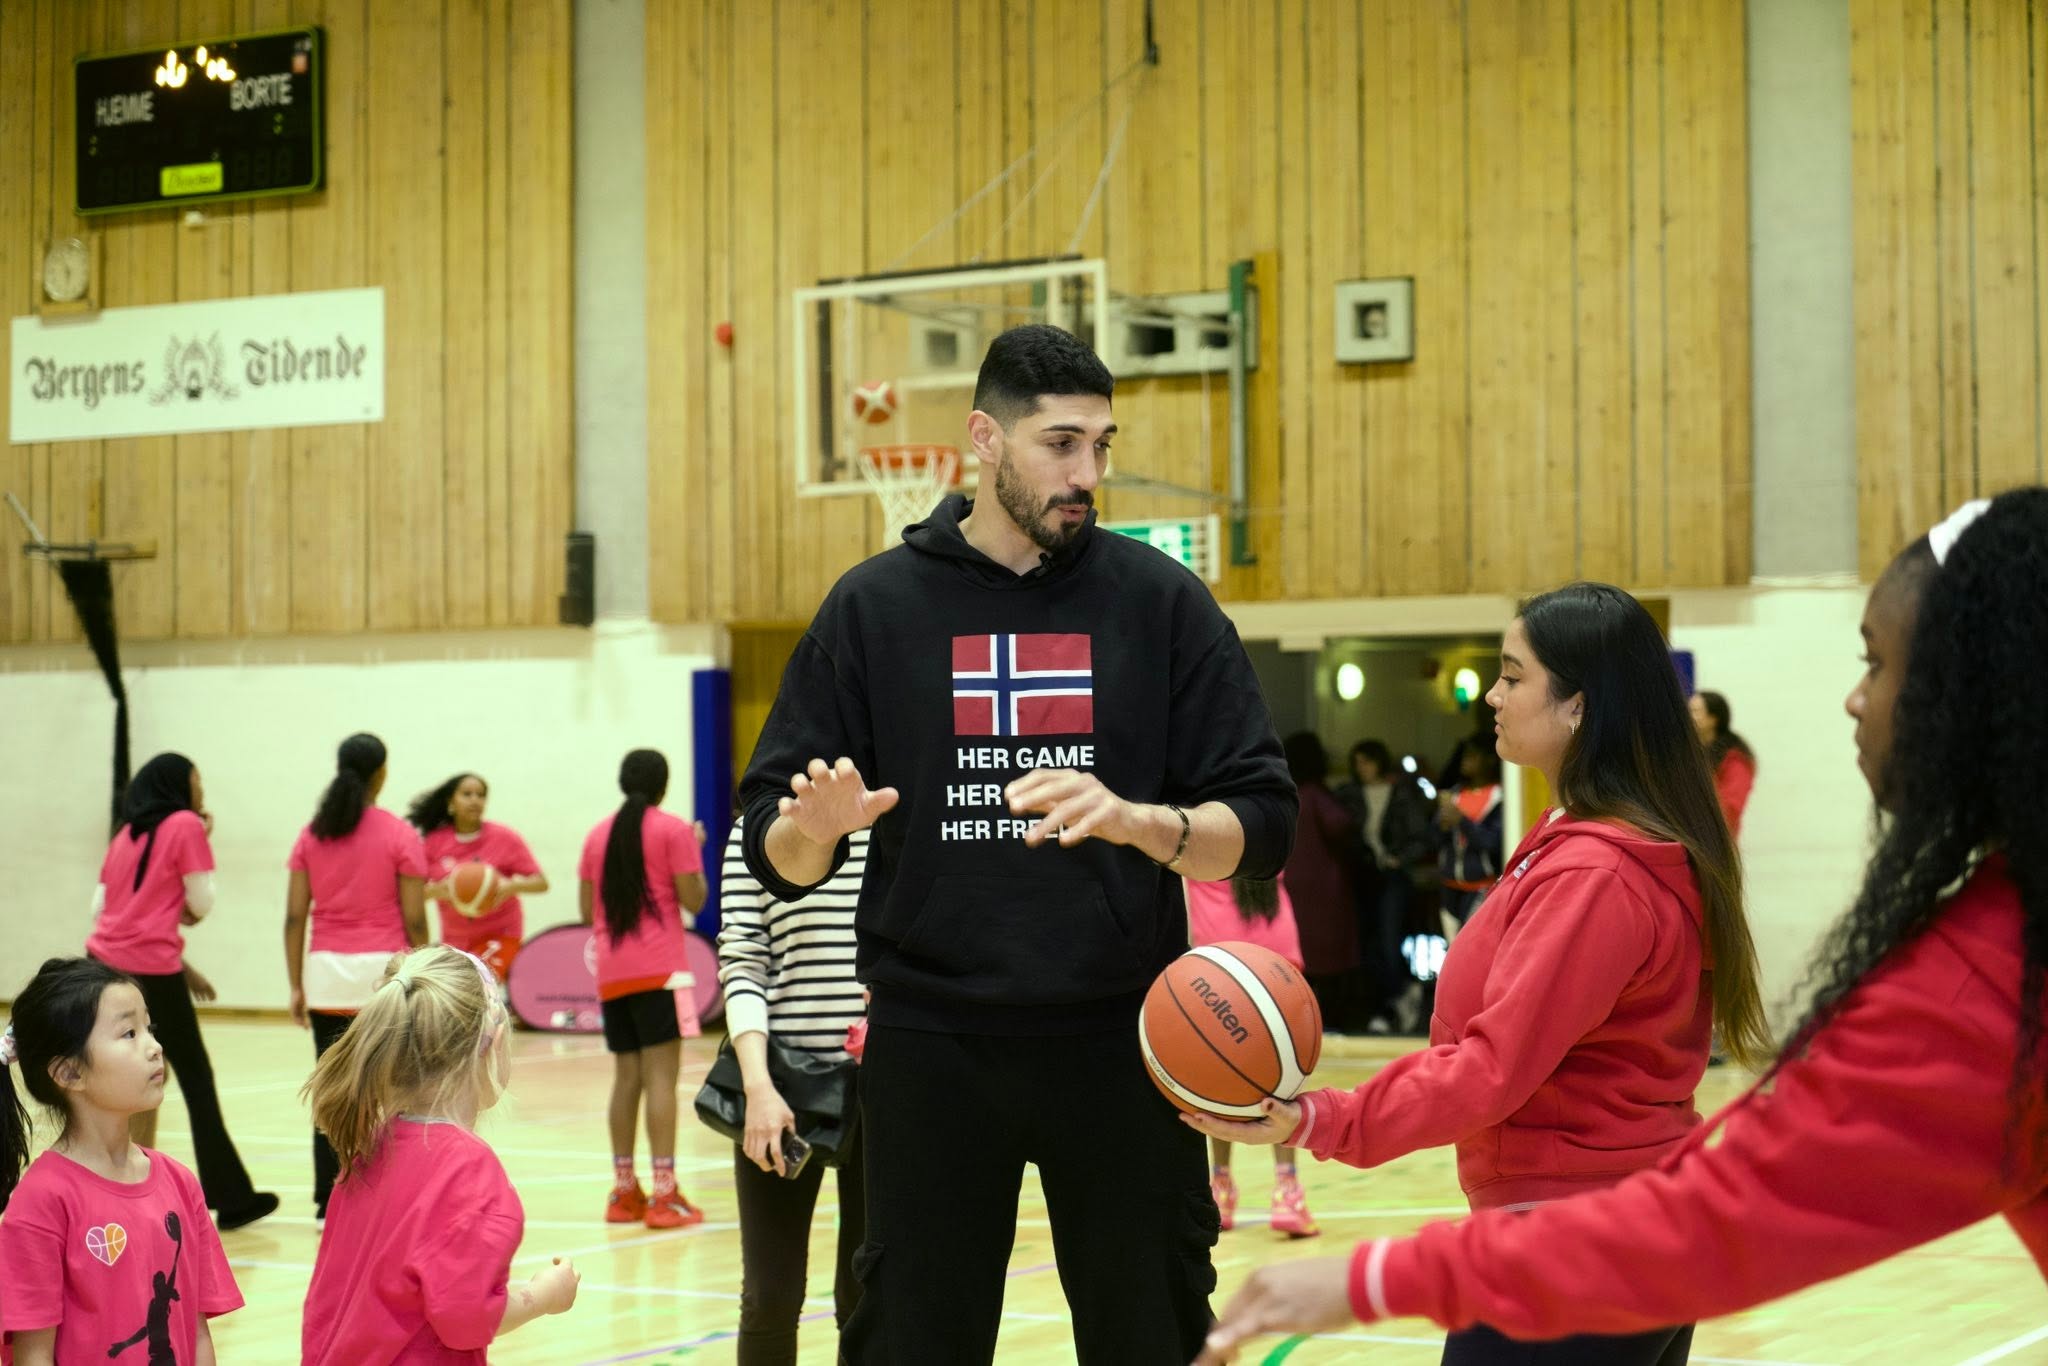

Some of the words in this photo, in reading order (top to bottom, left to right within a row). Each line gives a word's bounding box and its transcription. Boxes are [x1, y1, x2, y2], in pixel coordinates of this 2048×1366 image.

[230, 72, 294, 111] BORTE
[25, 355, 146, 410] Bergens
[240, 333, 367, 387] Tidende
[957, 747, 1009, 769] HER
[1015, 745, 1095, 768] GAME
[946, 784, 1002, 807] HER
[941, 820, 991, 841] HER
[1190, 976, 1249, 1044] molten
